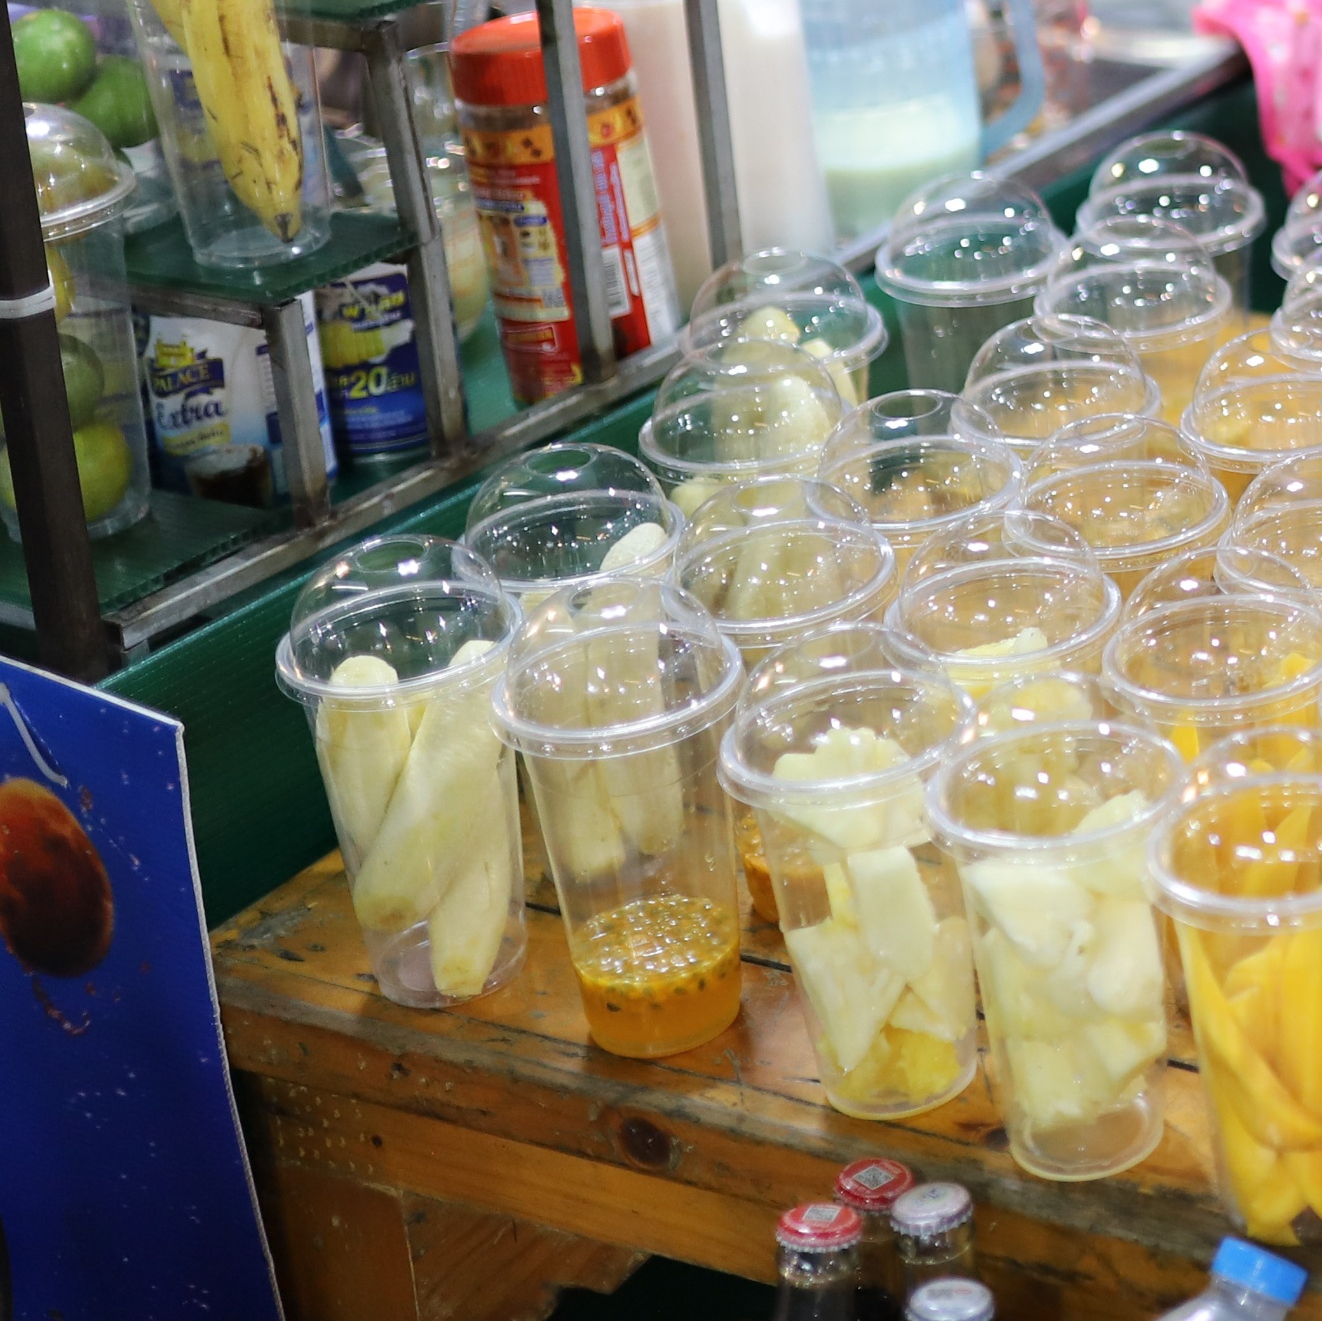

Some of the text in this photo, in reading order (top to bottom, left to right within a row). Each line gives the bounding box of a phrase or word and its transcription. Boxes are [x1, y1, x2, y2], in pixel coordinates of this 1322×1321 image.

[153, 363, 210, 392] PALACE
[350, 365, 388, 399] 20
[156, 398, 226, 431] Extra
